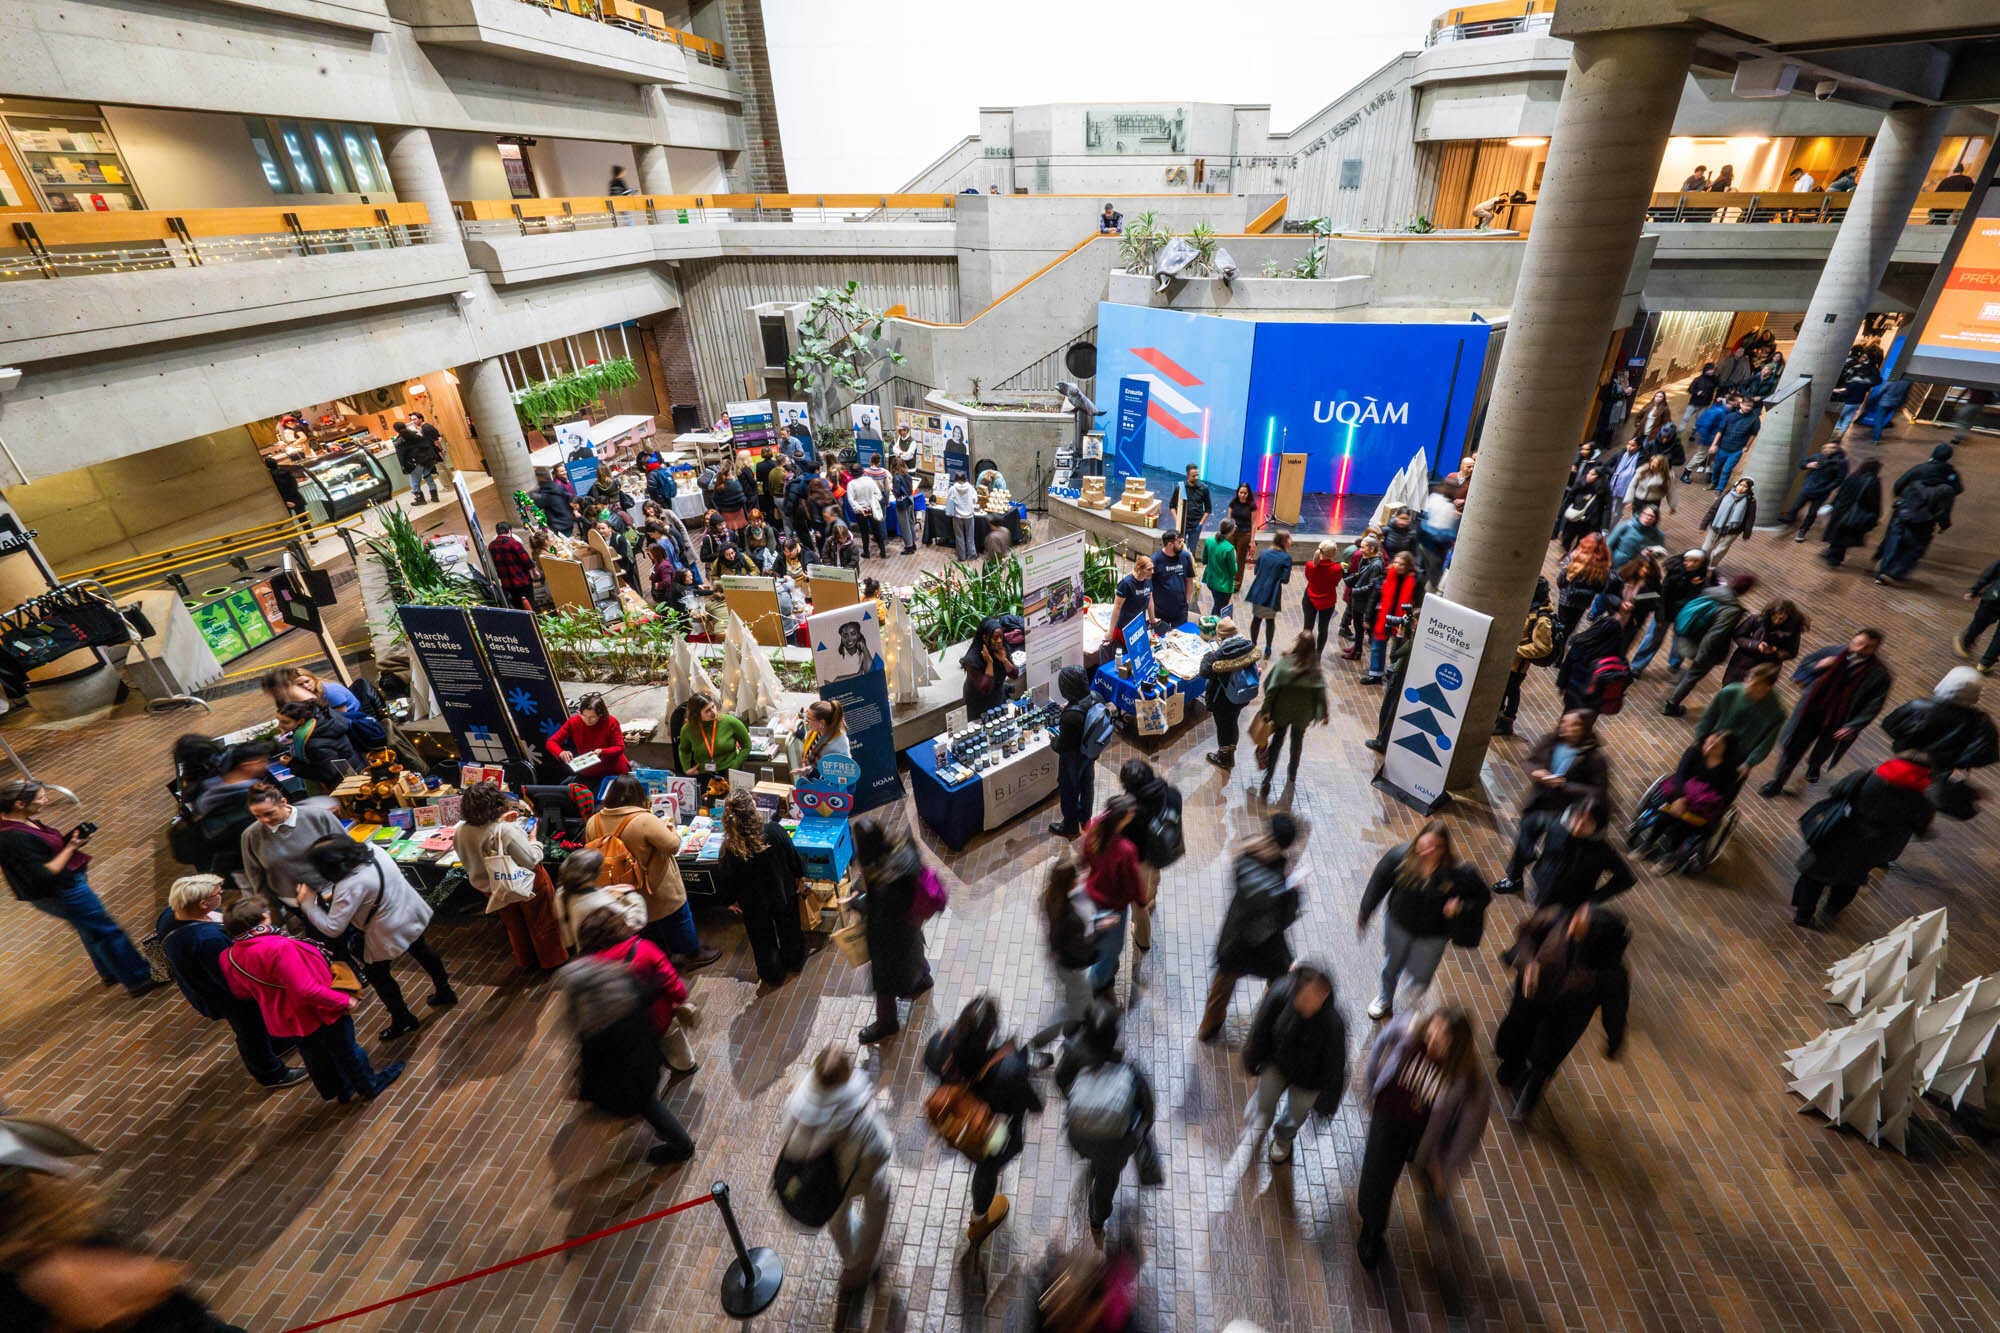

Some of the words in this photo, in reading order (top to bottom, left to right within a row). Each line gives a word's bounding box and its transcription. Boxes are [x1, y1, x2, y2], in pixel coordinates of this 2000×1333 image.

[1959, 271, 2000, 285] PRÉV
[1313, 396, 1409, 428] UQÀM
[1429, 616, 1464, 638] Marché
[413, 631, 450, 641] Marché
[484, 633, 519, 644] Marché
[1427, 627, 1444, 639] des
[1446, 633, 1471, 650] fêtes
[418, 641, 436, 649] des
[489, 643, 506, 651] des
[822, 760, 856, 769] OFFREZ
[995, 762, 1051, 800] BLESS
